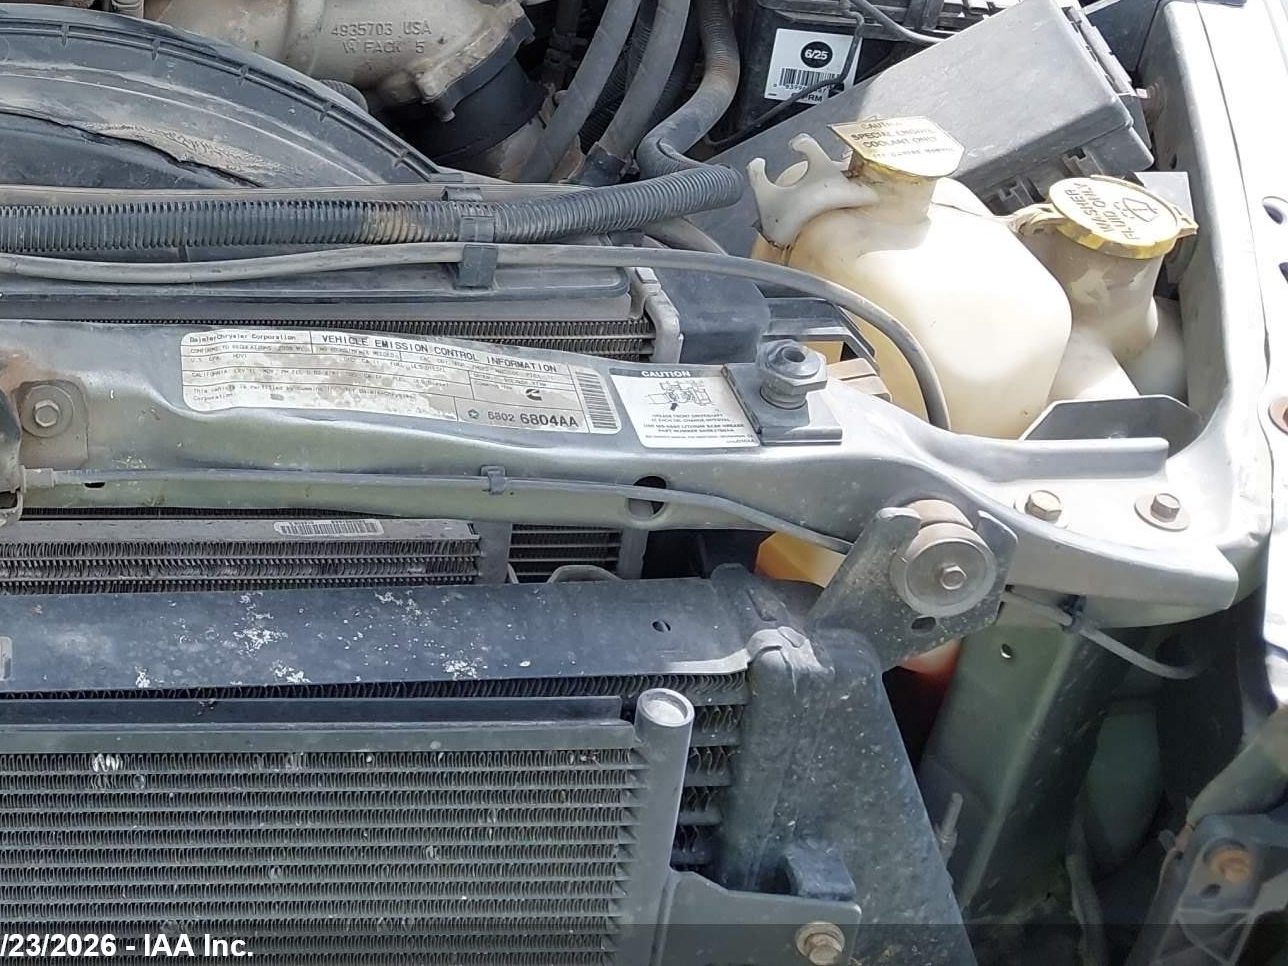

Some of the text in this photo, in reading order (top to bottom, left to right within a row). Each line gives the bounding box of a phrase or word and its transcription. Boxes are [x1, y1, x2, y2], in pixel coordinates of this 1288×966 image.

[330, 20, 432, 37] 4935703 USA
[415, 40, 425, 54] 5
[804, 48, 830, 61] 6/25
[1064, 188, 1115, 233] WASHER
[1073, 182, 1140, 240] FLUID ONLY
[321, 334, 368, 346] VEHICLE
[374, 339, 429, 353] EMISSION
[433, 346, 480, 362] CONTROL
[486, 356, 558, 373] INFORMATION
[641, 370, 691, 378] CAUTION
[487, 411, 579, 427] 6802 6804AA
